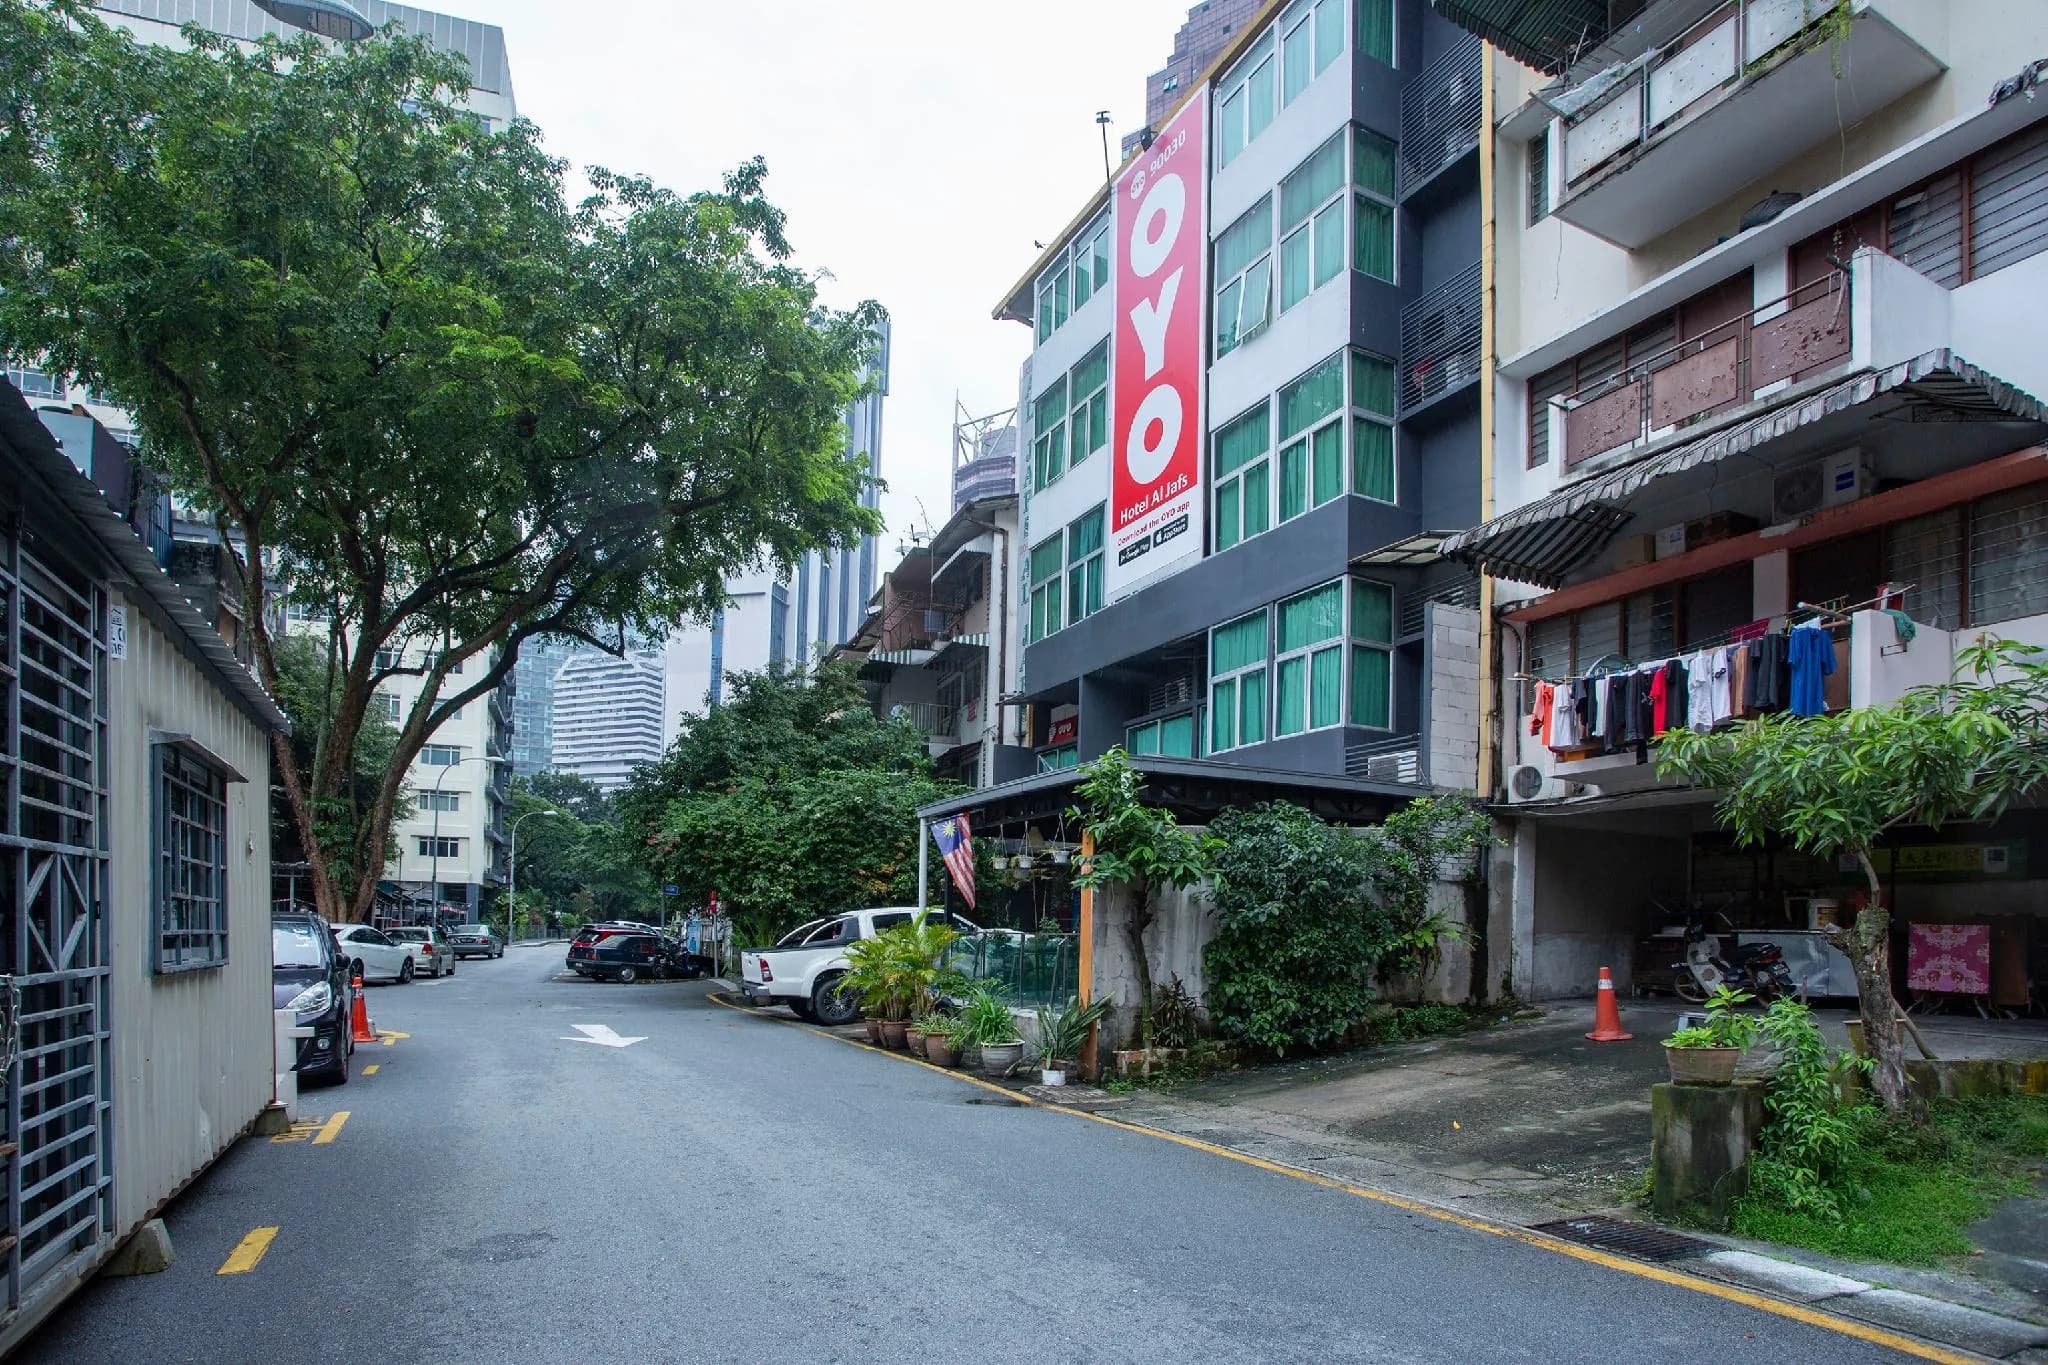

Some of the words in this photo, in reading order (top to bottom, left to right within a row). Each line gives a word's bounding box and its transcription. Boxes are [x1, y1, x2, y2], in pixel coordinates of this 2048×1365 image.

[1150, 128, 1186, 176] 90030
[1126, 173, 1186, 485] OYO
[1120, 494, 1149, 525] Hotel
[1151, 486, 1164, 506] Al
[1165, 473, 1187, 497] Jafs
[1149, 518, 1160, 528] the
[1161, 508, 1175, 521] OYO
[1177, 501, 1190, 513] app
